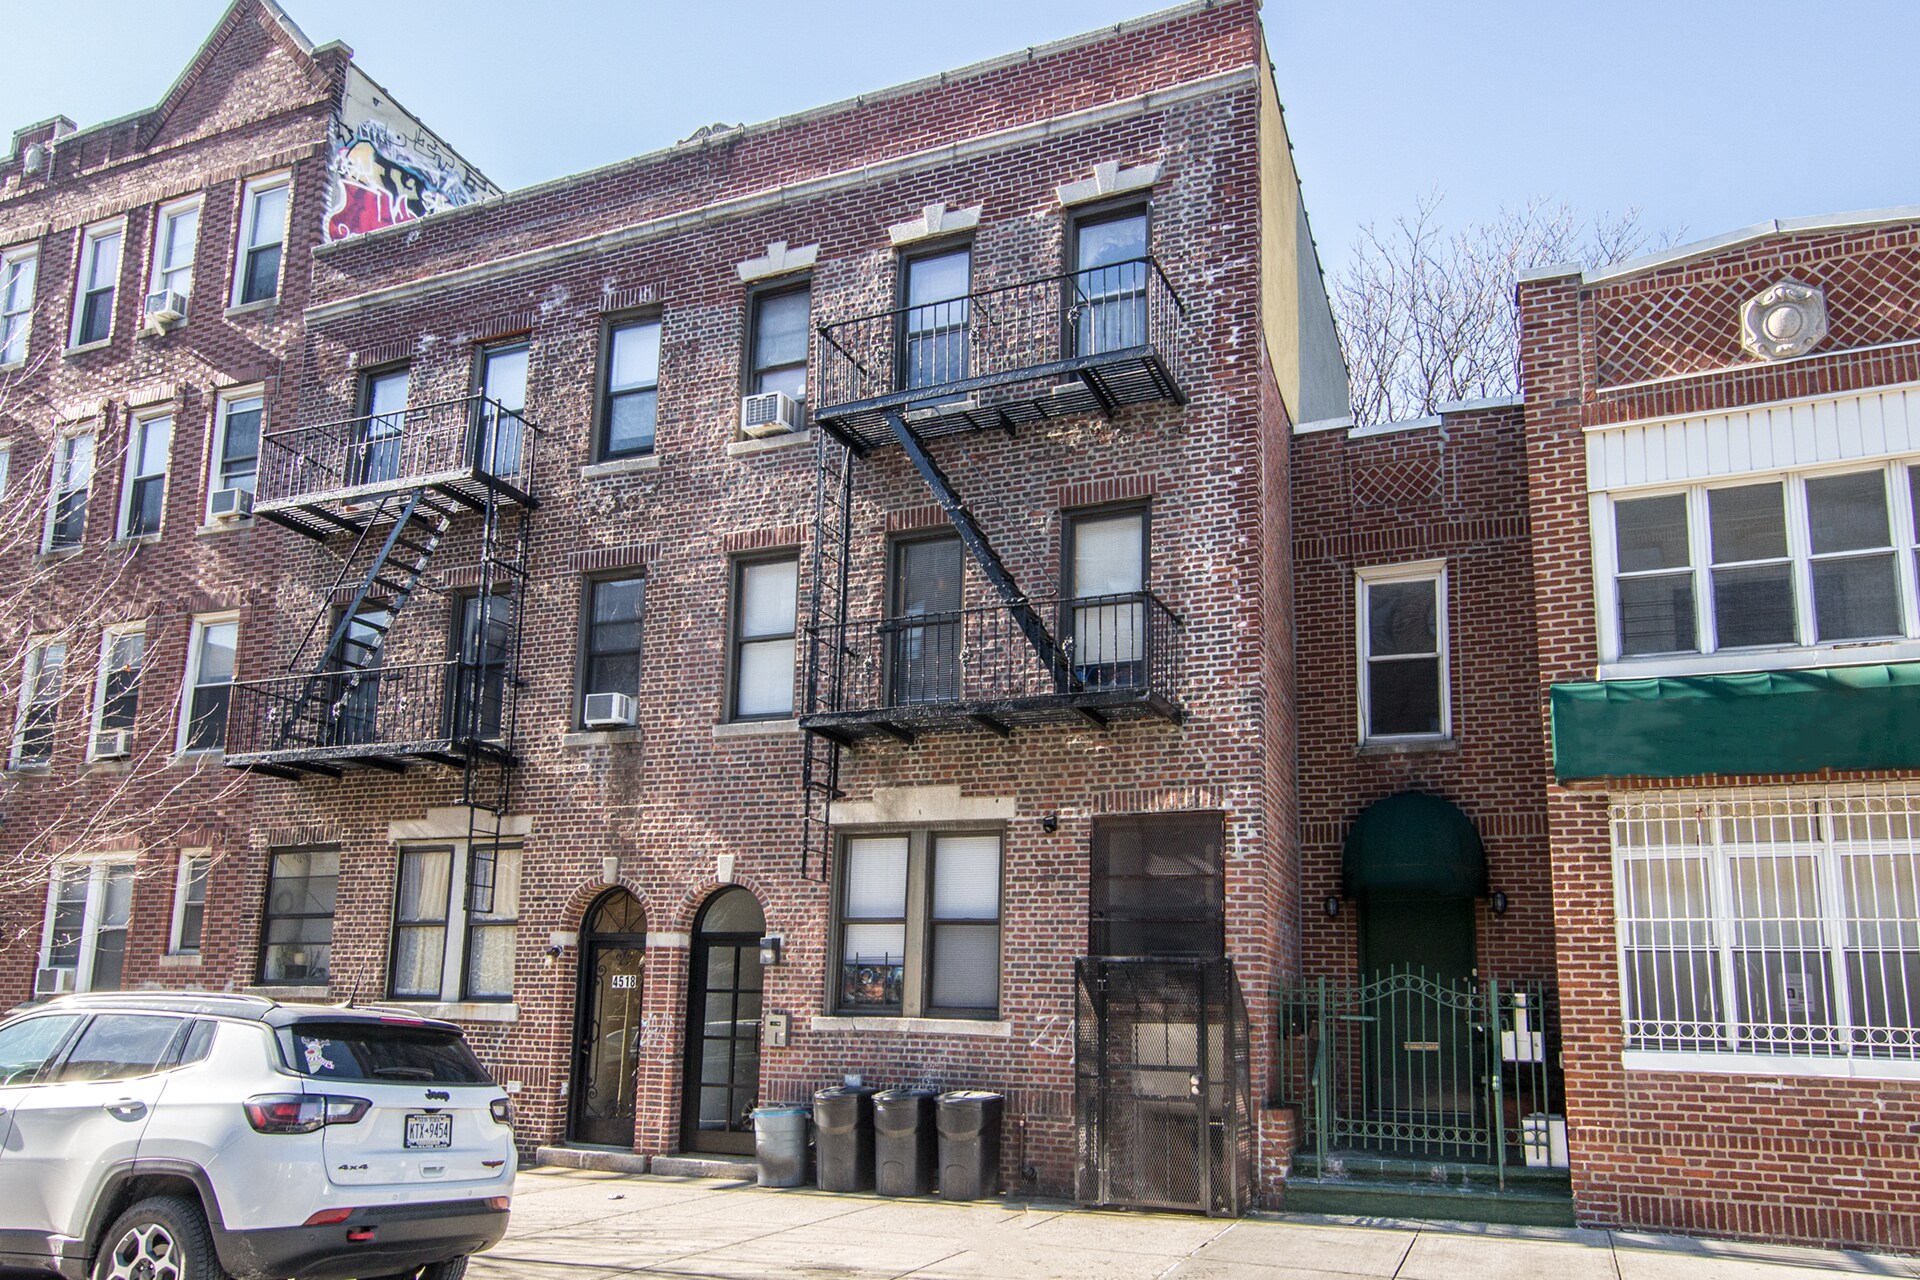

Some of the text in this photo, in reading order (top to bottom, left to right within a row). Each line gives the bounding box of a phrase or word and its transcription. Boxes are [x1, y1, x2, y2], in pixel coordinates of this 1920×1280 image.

[612, 975, 635, 987] 4518
[424, 1088, 450, 1102] Jeep
[338, 1163, 369, 1171] 4x4
